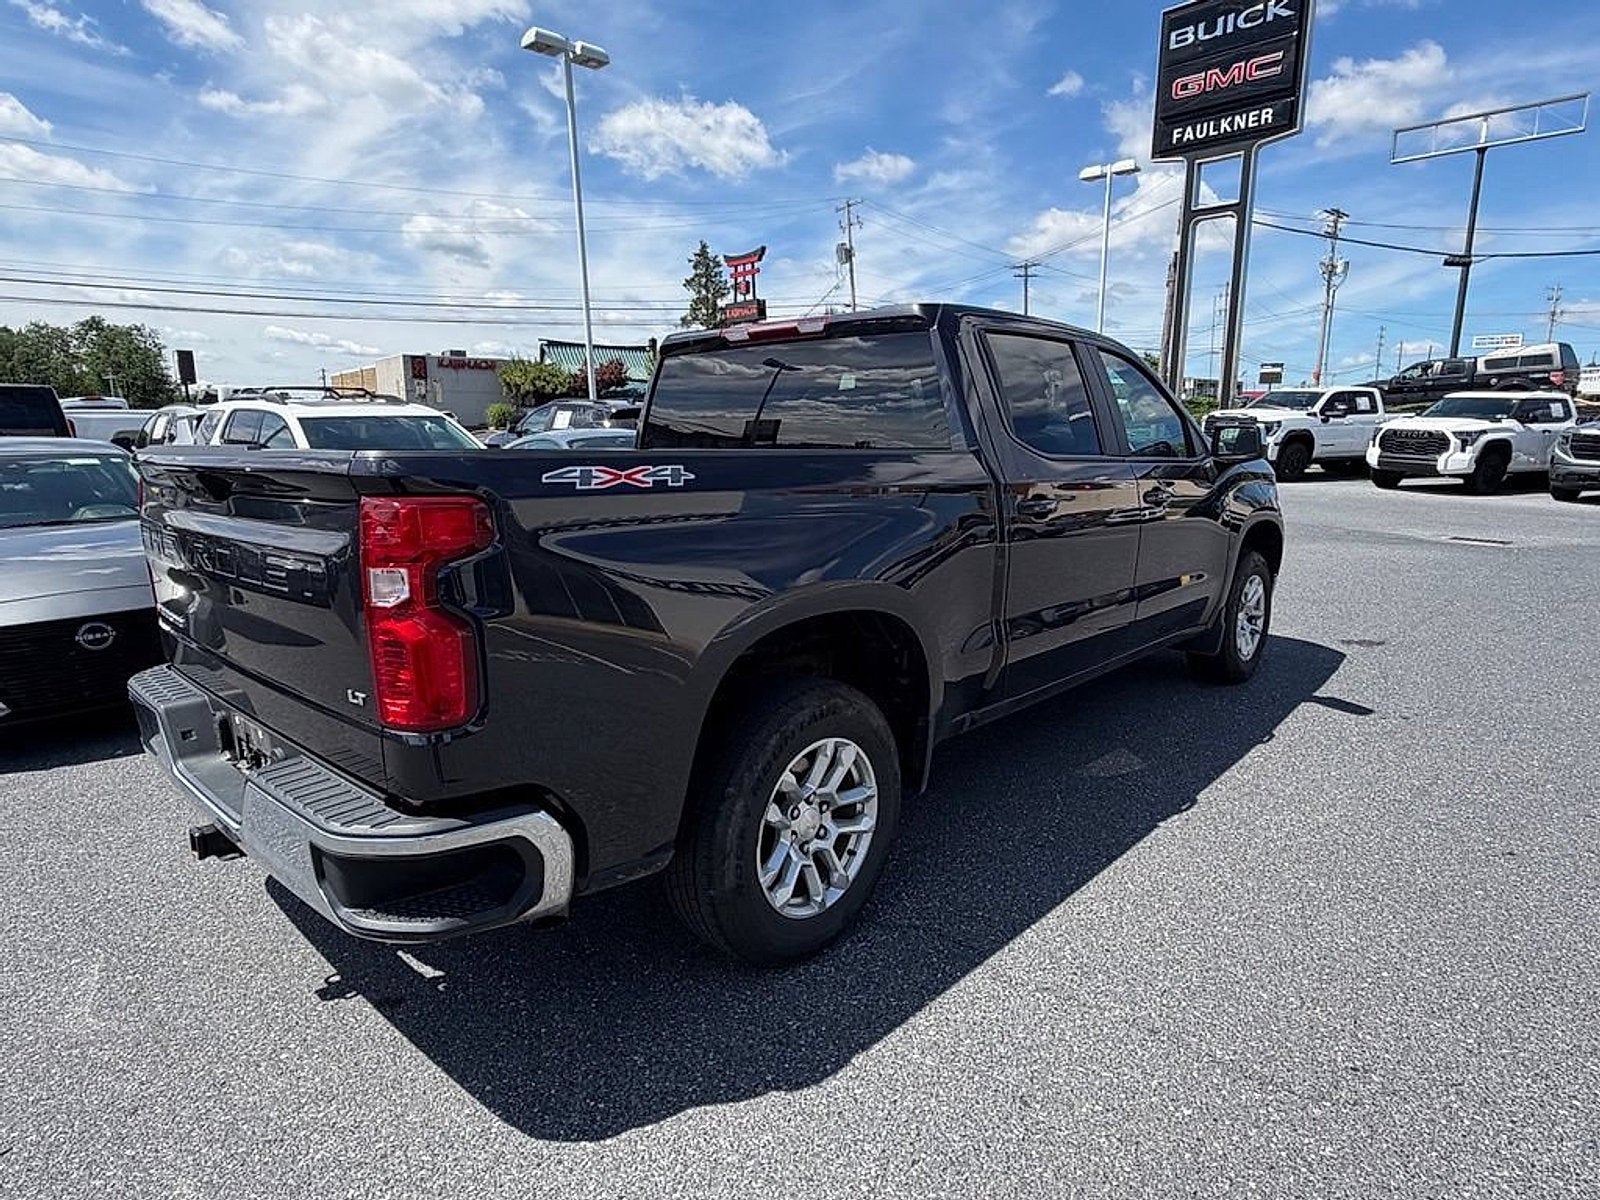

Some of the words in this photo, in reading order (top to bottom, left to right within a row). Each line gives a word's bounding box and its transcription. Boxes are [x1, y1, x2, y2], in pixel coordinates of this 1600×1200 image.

[1168, 0, 1296, 50] BUICK
[1171, 50, 1284, 100] GMC
[1172, 107, 1274, 145] FAULKNER
[346, 688, 367, 706] LT
